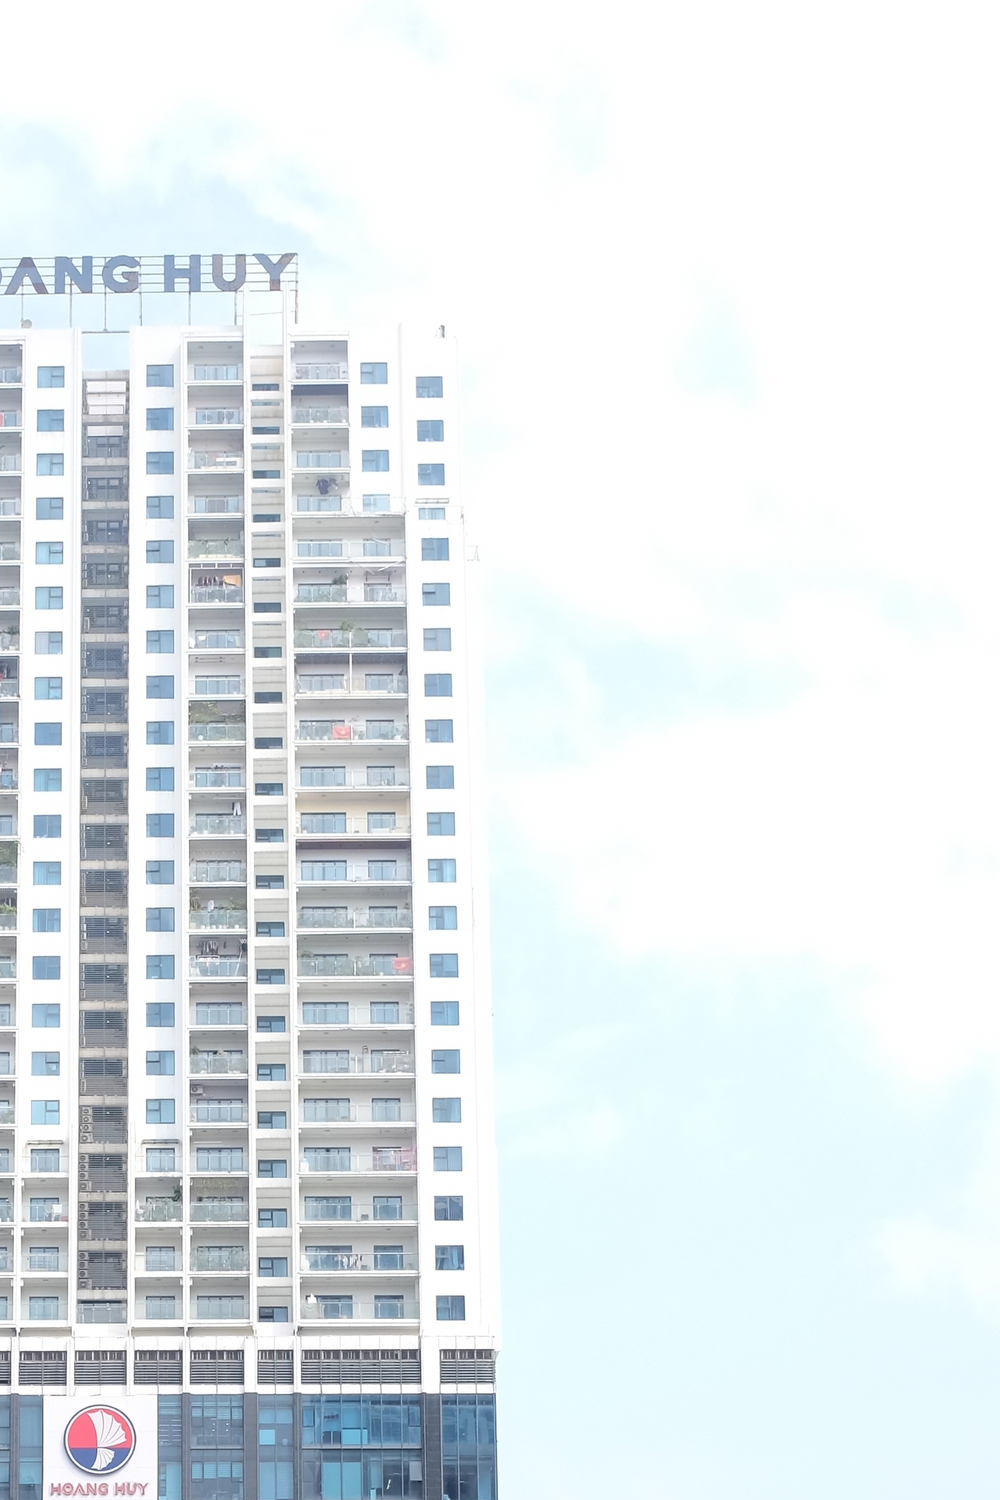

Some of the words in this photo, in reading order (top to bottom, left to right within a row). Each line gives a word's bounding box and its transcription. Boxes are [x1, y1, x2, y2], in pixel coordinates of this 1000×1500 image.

[163, 253, 298, 292] HUY
[50, 1482, 109, 1496] HOANG
[114, 1482, 149, 1496] HUY
